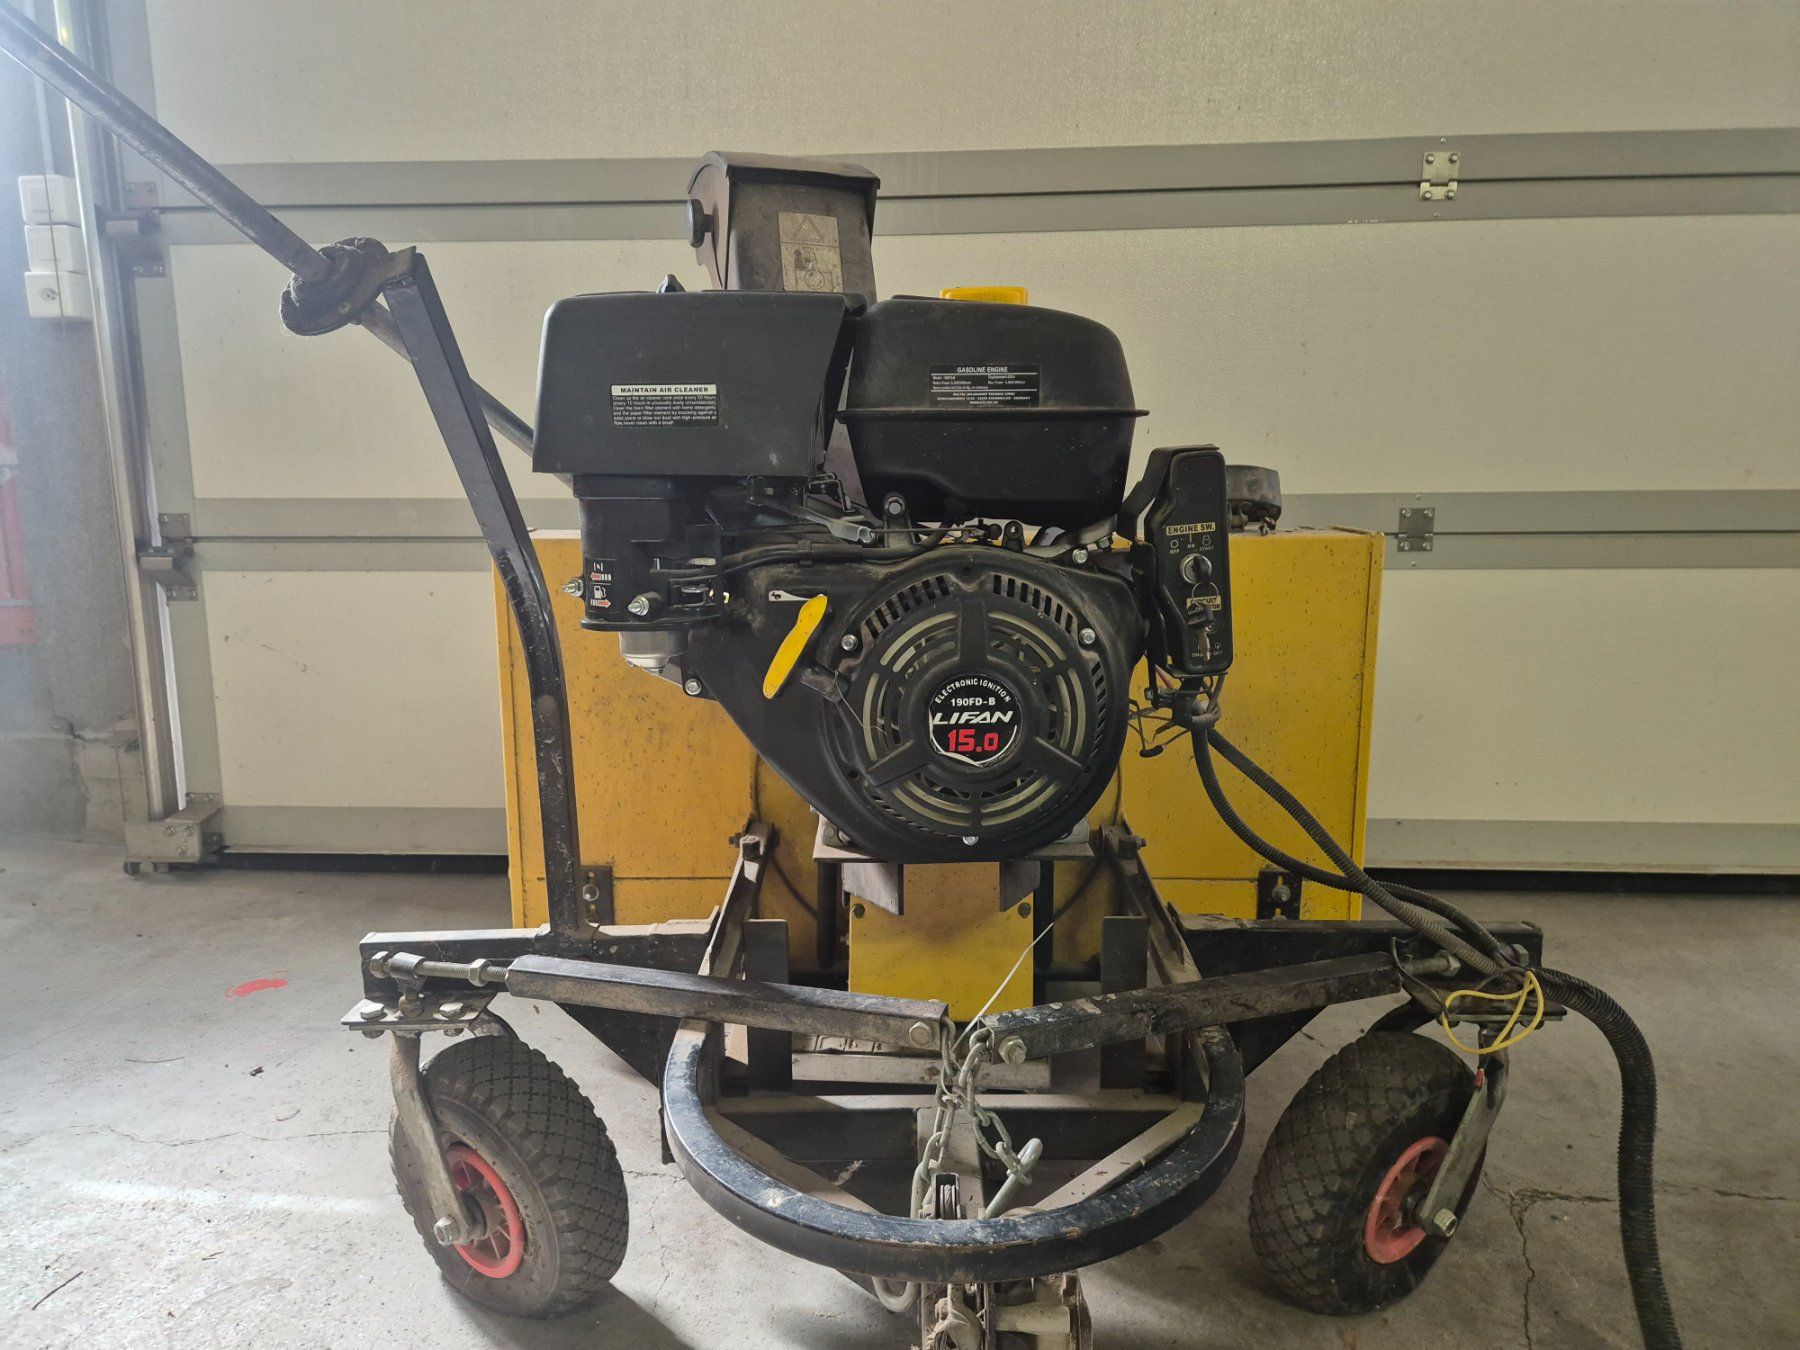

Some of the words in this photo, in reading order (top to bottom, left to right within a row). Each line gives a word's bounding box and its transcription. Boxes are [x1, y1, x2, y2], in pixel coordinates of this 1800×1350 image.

[1168, 525, 1198, 534] ENGINE
[935, 679, 978, 704] ELECTRONIC
[980, 679, 1011, 702] IGNITION
[951, 697, 996, 707] 190FD-B
[933, 711, 1013, 724] LIFAN
[948, 729, 999, 752] 15.0
